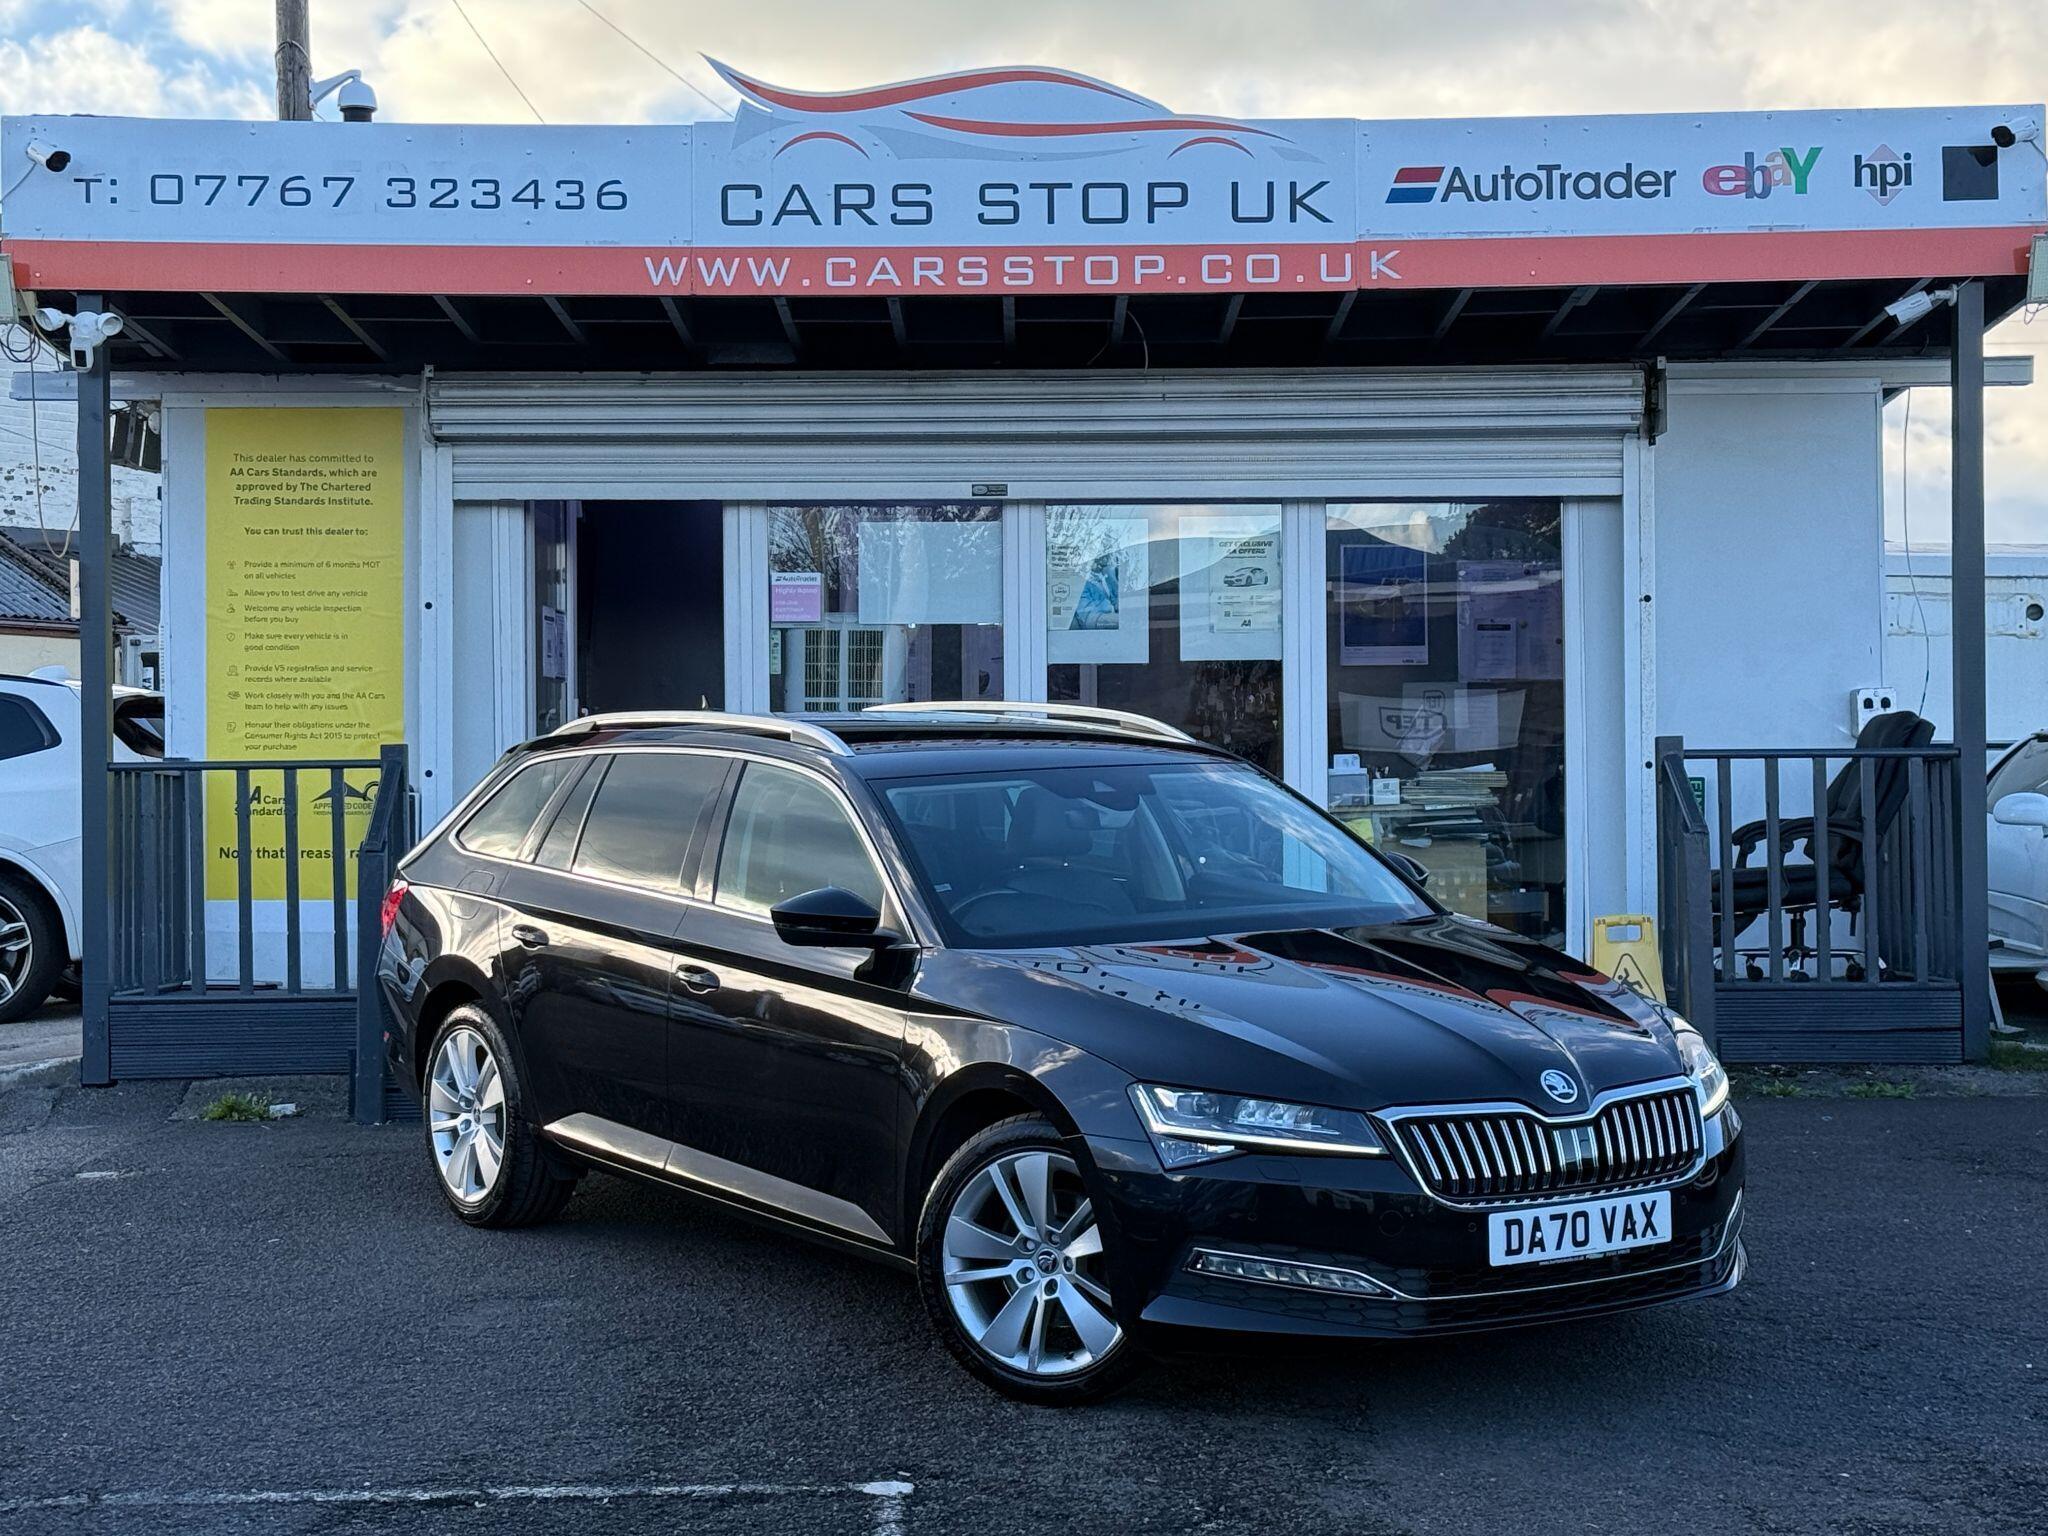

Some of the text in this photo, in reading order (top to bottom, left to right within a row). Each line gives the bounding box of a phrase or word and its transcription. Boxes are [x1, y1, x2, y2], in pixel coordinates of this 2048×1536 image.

[1853, 152, 1913, 197] hpi
[1440, 162, 1678, 204] AutoTrader
[73, 174, 629, 211] T: 07767 323436
[720, 180, 1335, 226] CARS STOP UK
[644, 250, 1402, 287] WWW.CARSSTOP.CO.UK
[233, 454, 254, 462] This
[256, 454, 287, 462] dealer
[289, 454, 306, 462] has
[309, 454, 361, 462] committed
[230, 468, 244, 477] AA
[247, 468, 270, 477] Cars
[329, 468, 359, 477] which
[361, 468, 377, 477] are
[236, 483, 283, 492] approved
[286, 483, 298, 492] by
[321, 483, 372, 491] Chartered
[233, 497, 374, 506] Trading Standards Institute.
[244, 527, 261, 536] You
[282, 527, 304, 536] trust
[306, 527, 323, 536] this
[325, 527, 353, 536] dealer
[323, 605, 362, 613] inspection
[285, 616, 299, 624] buy
[244, 645, 263, 653] good
[286, 665, 329, 673] registration
[266, 692, 292, 700] closely
[1504, 1200, 1658, 1257] DA70 VAX
